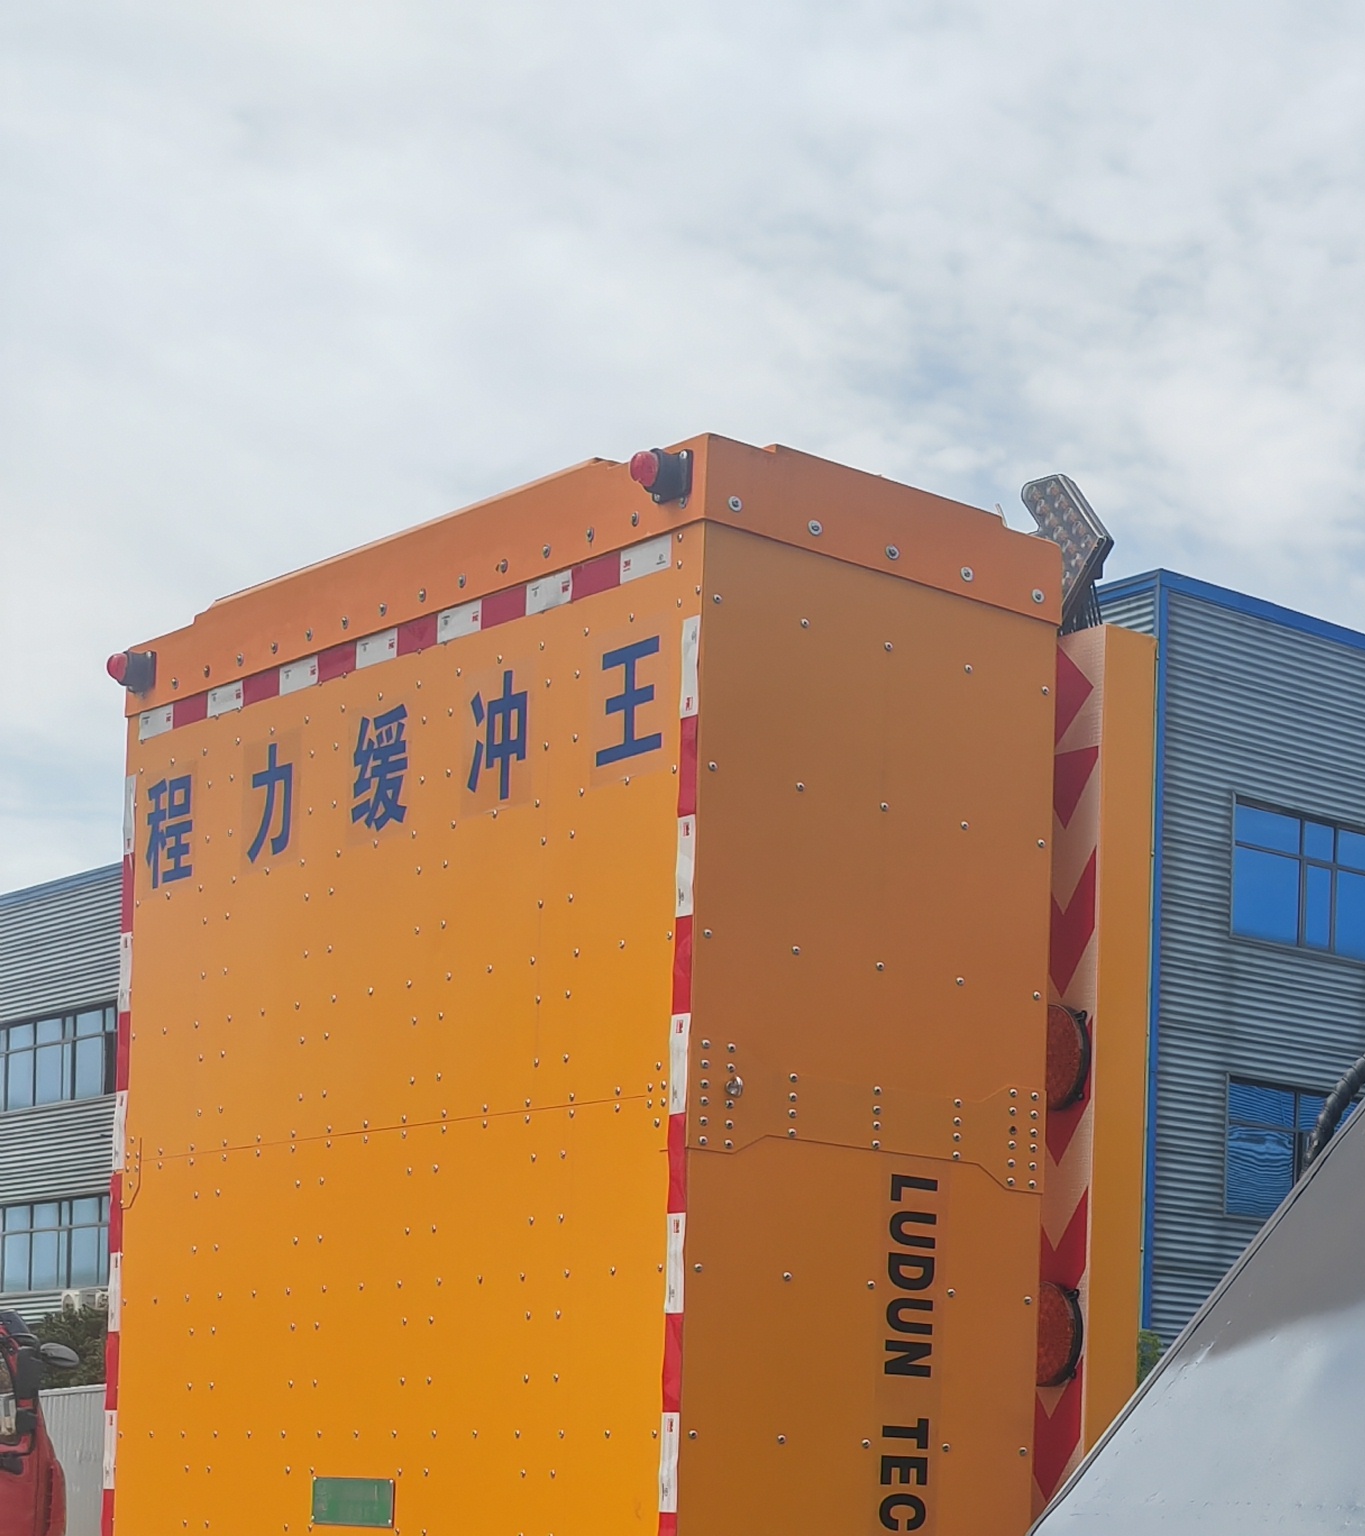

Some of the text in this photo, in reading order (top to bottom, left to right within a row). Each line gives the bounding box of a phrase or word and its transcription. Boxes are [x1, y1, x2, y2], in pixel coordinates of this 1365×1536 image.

[146, 635, 662, 889] 程力缓冲王
[883, 1173, 938, 1378] LUDUN
